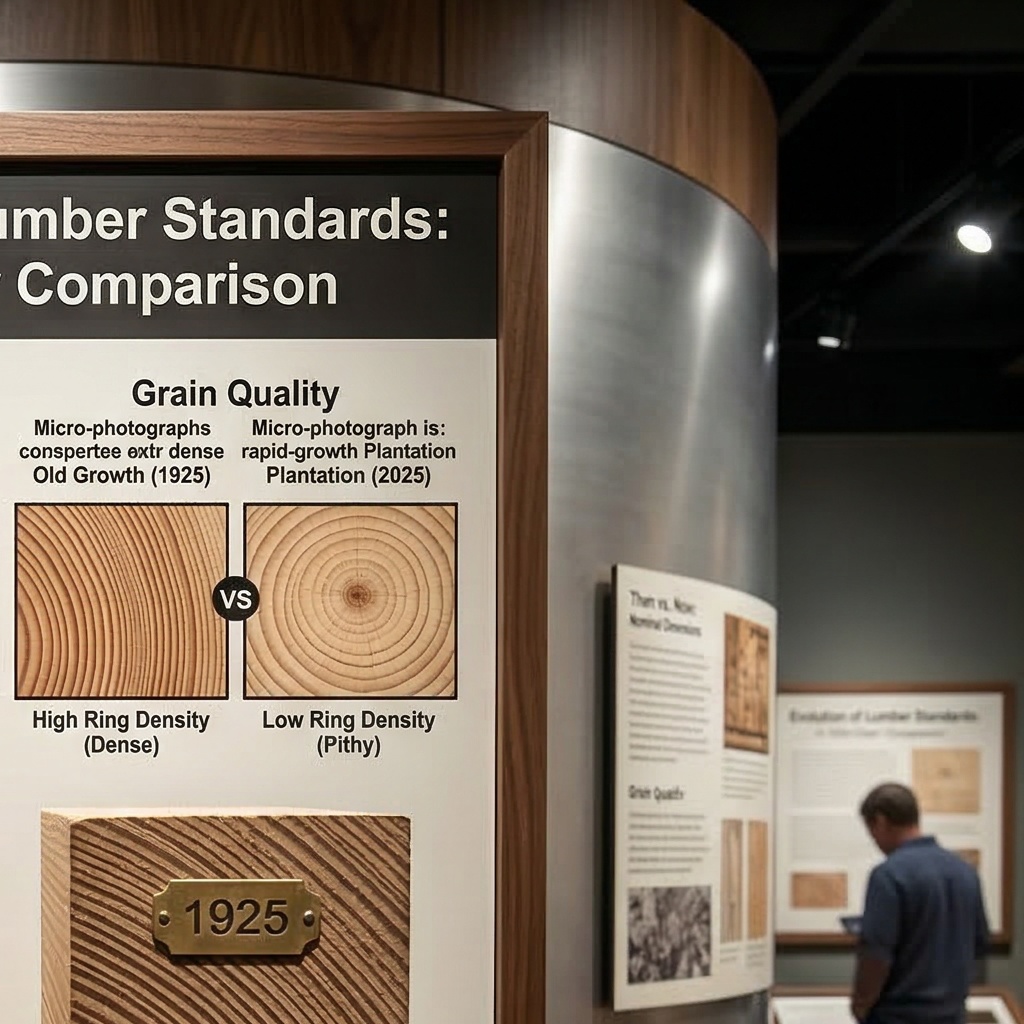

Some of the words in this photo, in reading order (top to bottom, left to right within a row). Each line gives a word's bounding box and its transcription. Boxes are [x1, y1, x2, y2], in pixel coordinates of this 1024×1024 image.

[163, 197, 446, 240] Standards:
[18, 262, 336, 315] Comparison
[133, 379, 216, 406] Grain
[228, 379, 339, 413] Quality
[35, 419, 210, 440] Micro-photographs
[253, 419, 417, 440] Micro-photograph
[424, 420, 445, 436] is:
[20, 444, 121, 461] conspertee
[169, 443, 224, 459] dense
[242, 443, 357, 461] rapid-growth
[365, 443, 455, 459] Plantation
[34, 466, 66, 483] Old
[74, 466, 144, 483] Growth
[152, 466, 210, 488] (1925)
[267, 466, 364, 483] Plantation
[372, 466, 430, 488] (2025)
[220, 590, 251, 609] VS
[34, 711, 77, 732] High
[85, 711, 129, 732] Ring
[137, 711, 210, 732] Density
[263, 711, 304, 728] Low
[311, 711, 354, 732] Ring
[362, 710, 435, 732] Density
[85, 736, 159, 757] (Dense)
[318, 735, 380, 757] (Pithy)
[186, 898, 289, 936] 1925
